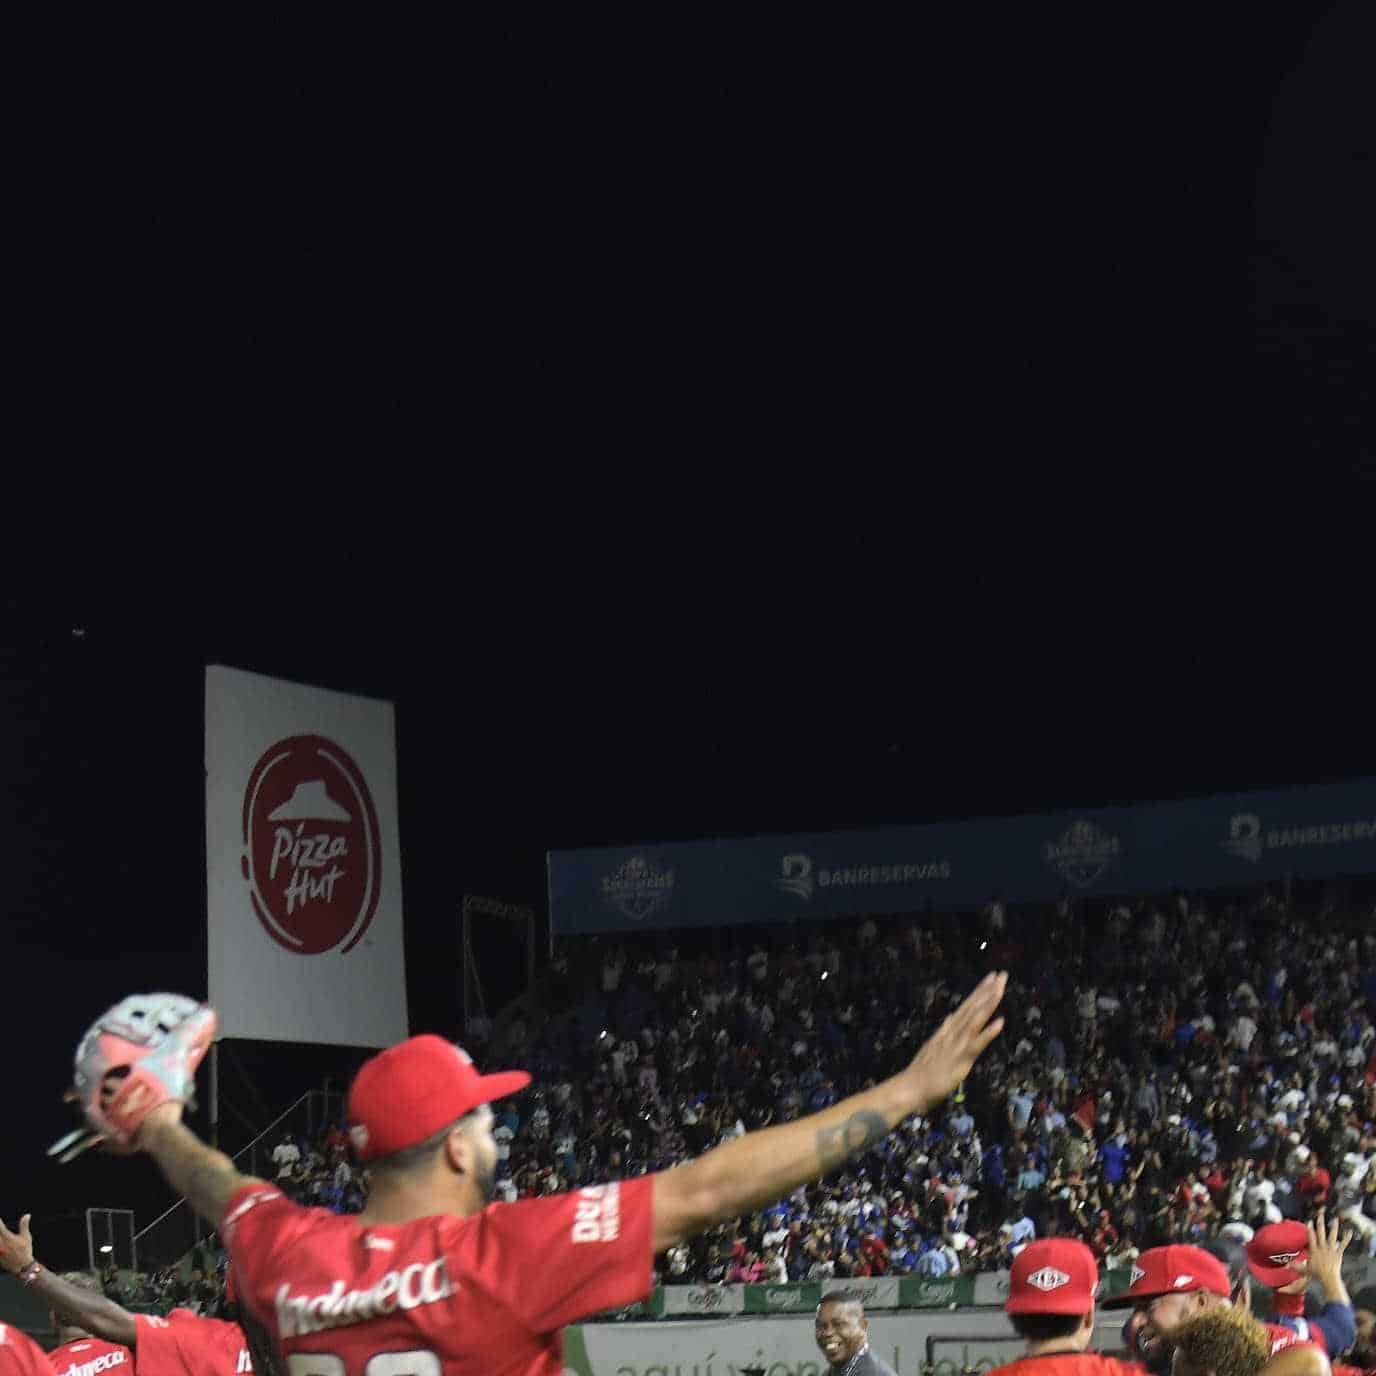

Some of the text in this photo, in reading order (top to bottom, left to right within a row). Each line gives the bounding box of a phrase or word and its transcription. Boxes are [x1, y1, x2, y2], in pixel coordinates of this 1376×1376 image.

[269, 820, 348, 879] Pizza
[285, 866, 347, 914] Hut
[275, 1256, 456, 1338] Induveca
